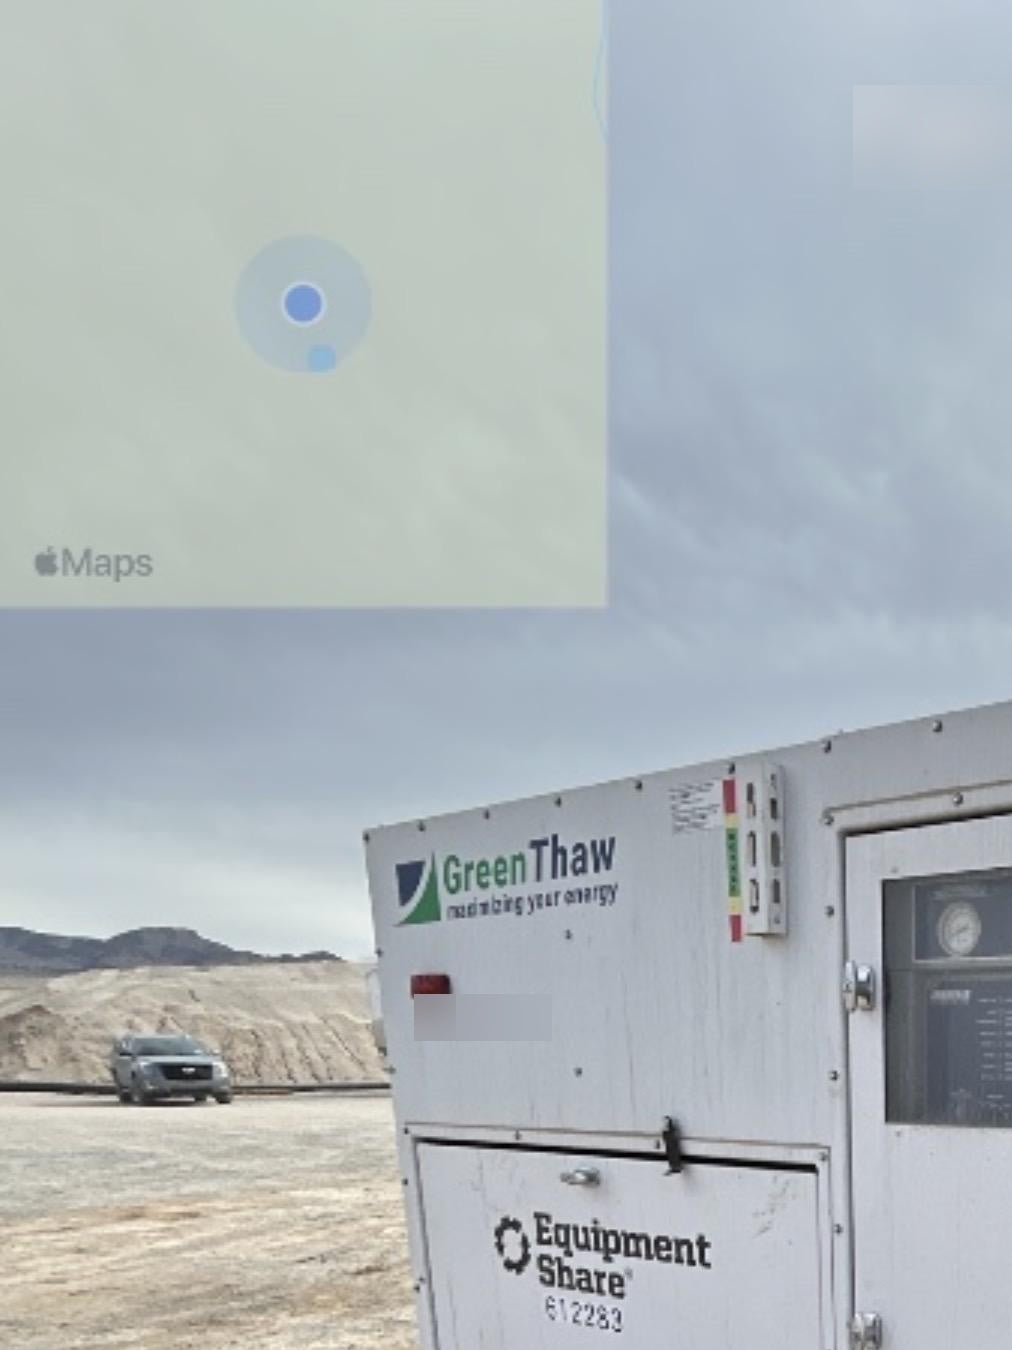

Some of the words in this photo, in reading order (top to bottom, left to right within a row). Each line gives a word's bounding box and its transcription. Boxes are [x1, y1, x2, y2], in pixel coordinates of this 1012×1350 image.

[443, 833, 617, 895] GreenThaw
[526, 889, 561, 916] your
[564, 882, 619, 907] energy
[533, 1211, 712, 1270] Equipment
[544, 1294, 623, 1333] 612283
